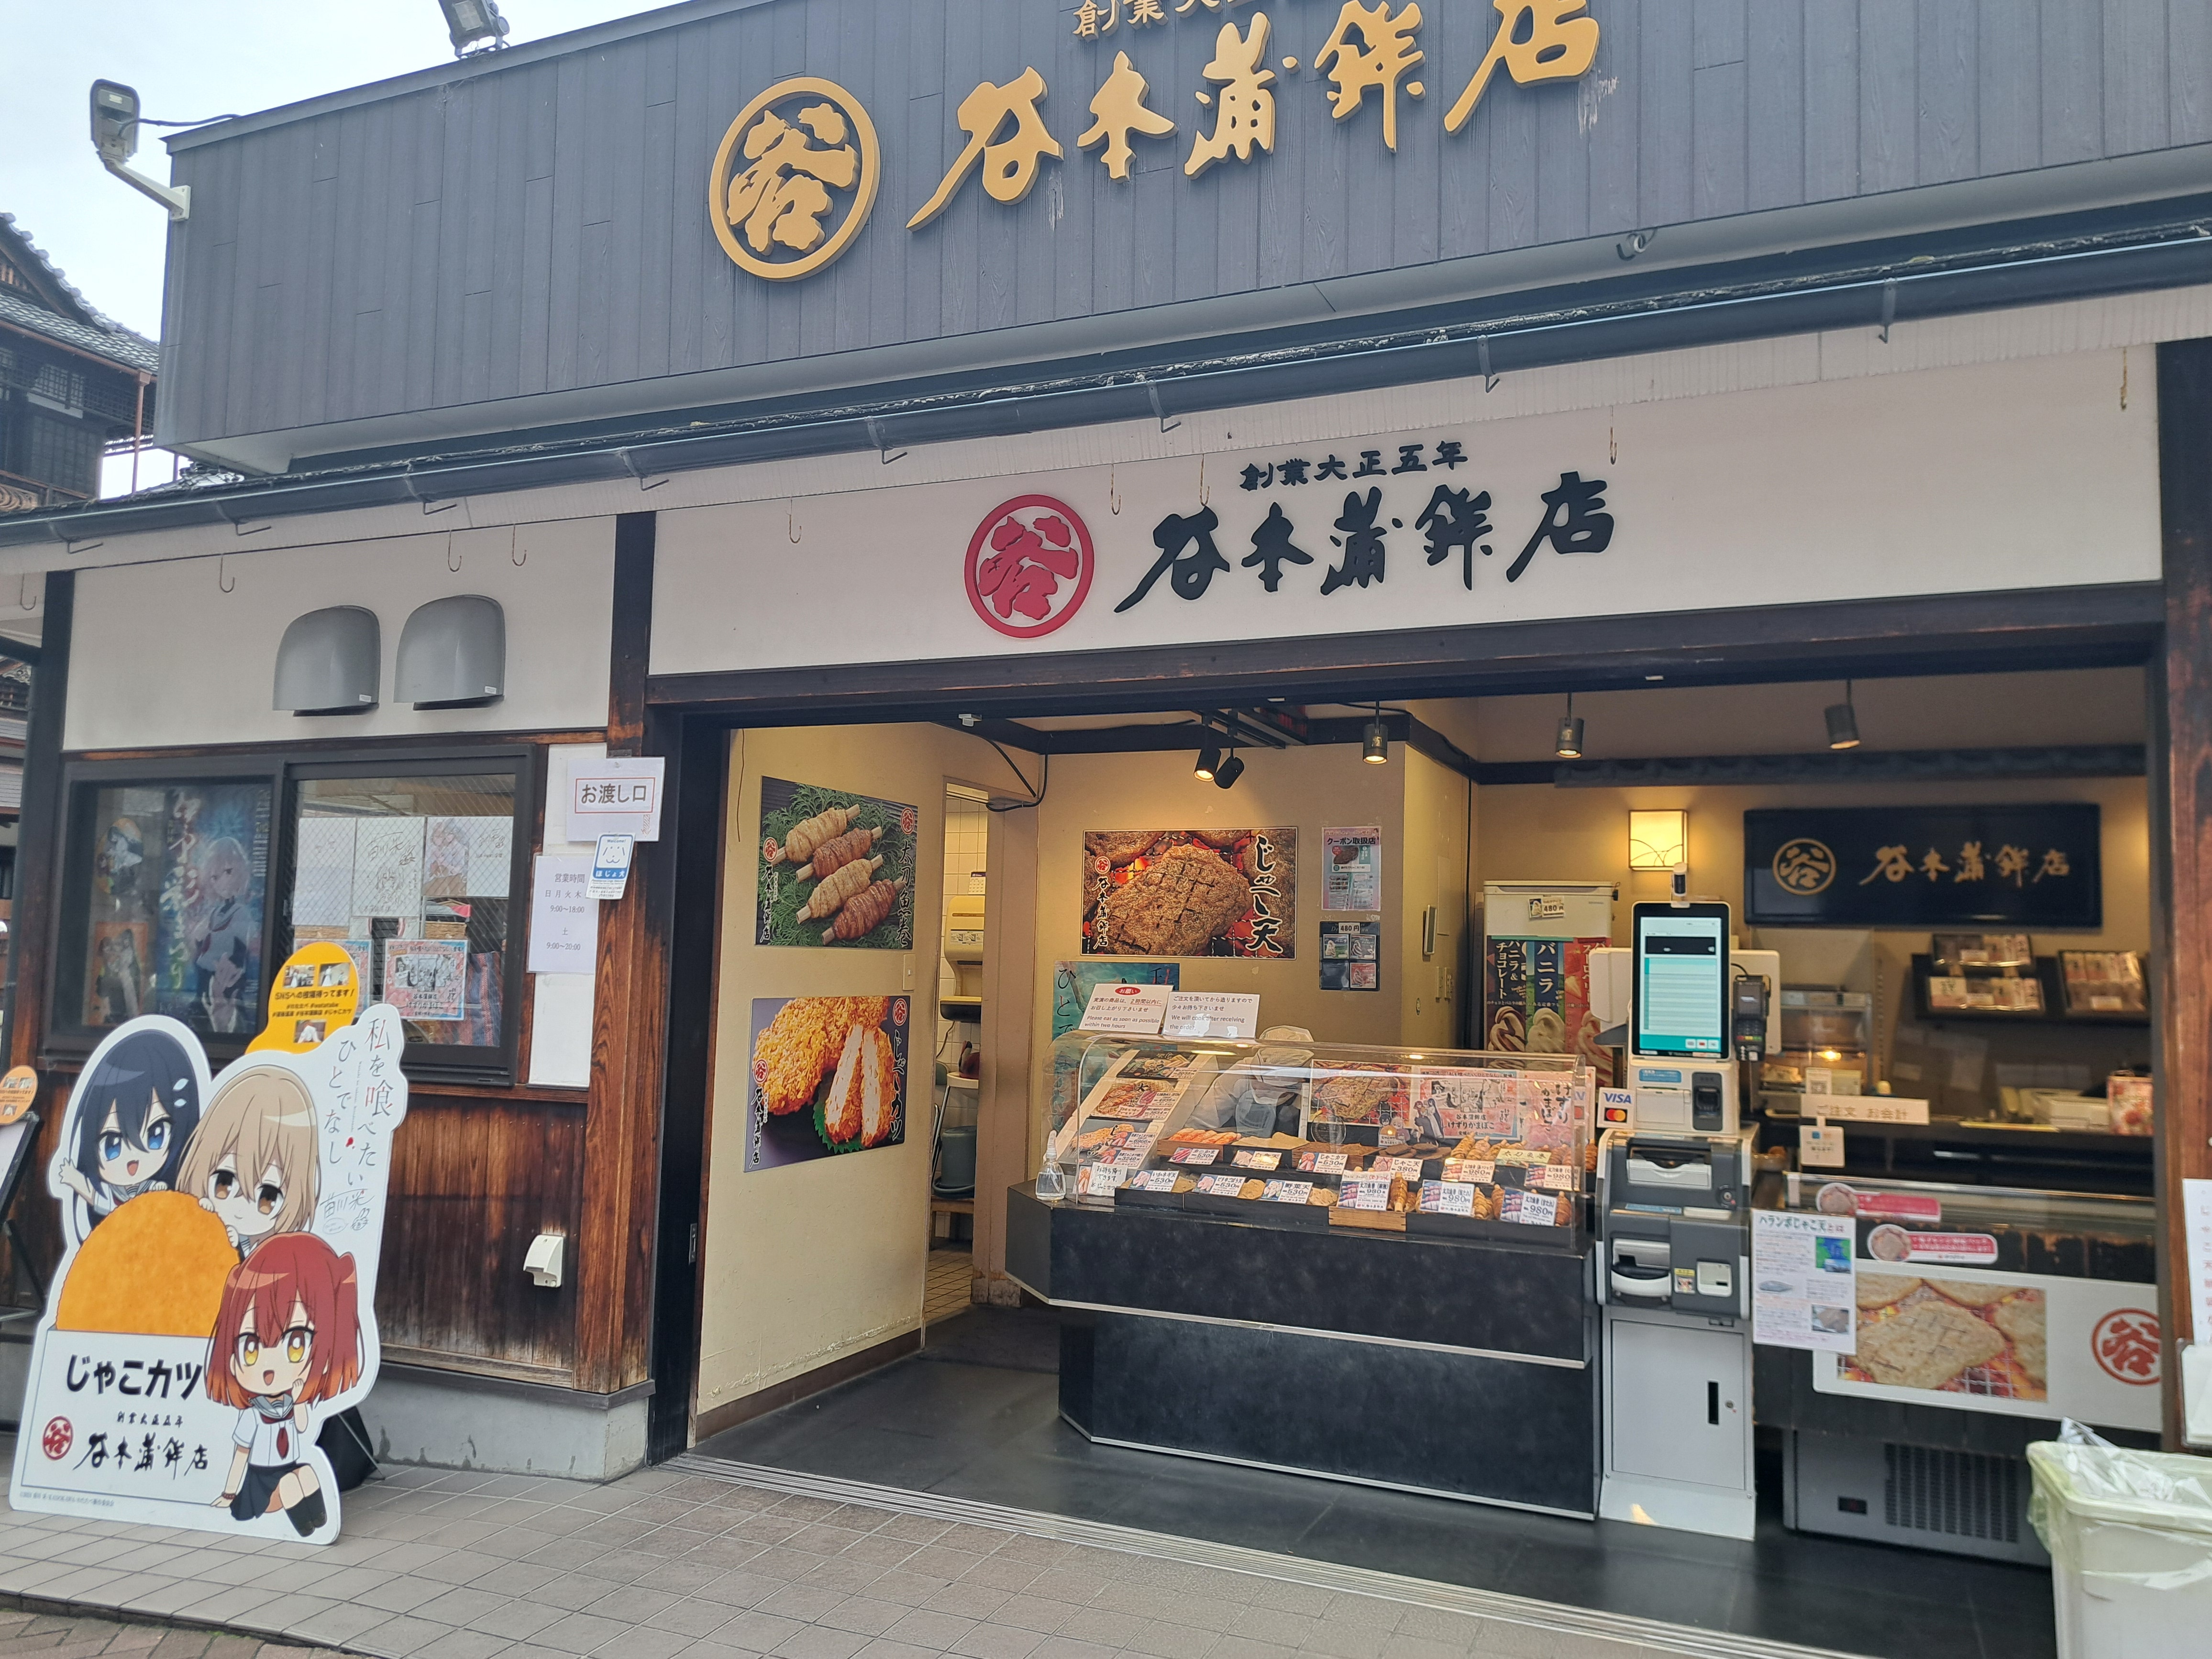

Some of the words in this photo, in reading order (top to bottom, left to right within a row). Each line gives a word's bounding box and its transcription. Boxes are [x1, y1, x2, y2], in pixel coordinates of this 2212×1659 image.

[1239, 442, 1468, 491] 創業大正五年
[581, 784, 647, 804] お渡し口
[1327, 837, 1376, 845] クーポン取扱店
[554, 873, 585, 883] 営業時間
[896, 840, 913, 947] 太刀魚巻
[1246, 834, 1283, 952] じゃこ天
[1496, 941, 1508, 999] チョコレート
[1508, 940, 1521, 981] バニラ&
[1537, 942, 1557, 994] バニラ
[323, 1040, 357, 1164] ひとでなし
[347, 1018, 394, 1186] 私を喰べたい
[1604, 1093, 1632, 1104] VISA
[1816, 1104, 1858, 1117] ご注文
[1868, 1107, 1908, 1119] お会計
[1449, 1194, 1471, 1203] 980円
[1530, 1205, 1553, 1216] 980円
[66, 1354, 203, 1401] じゃこカツ
